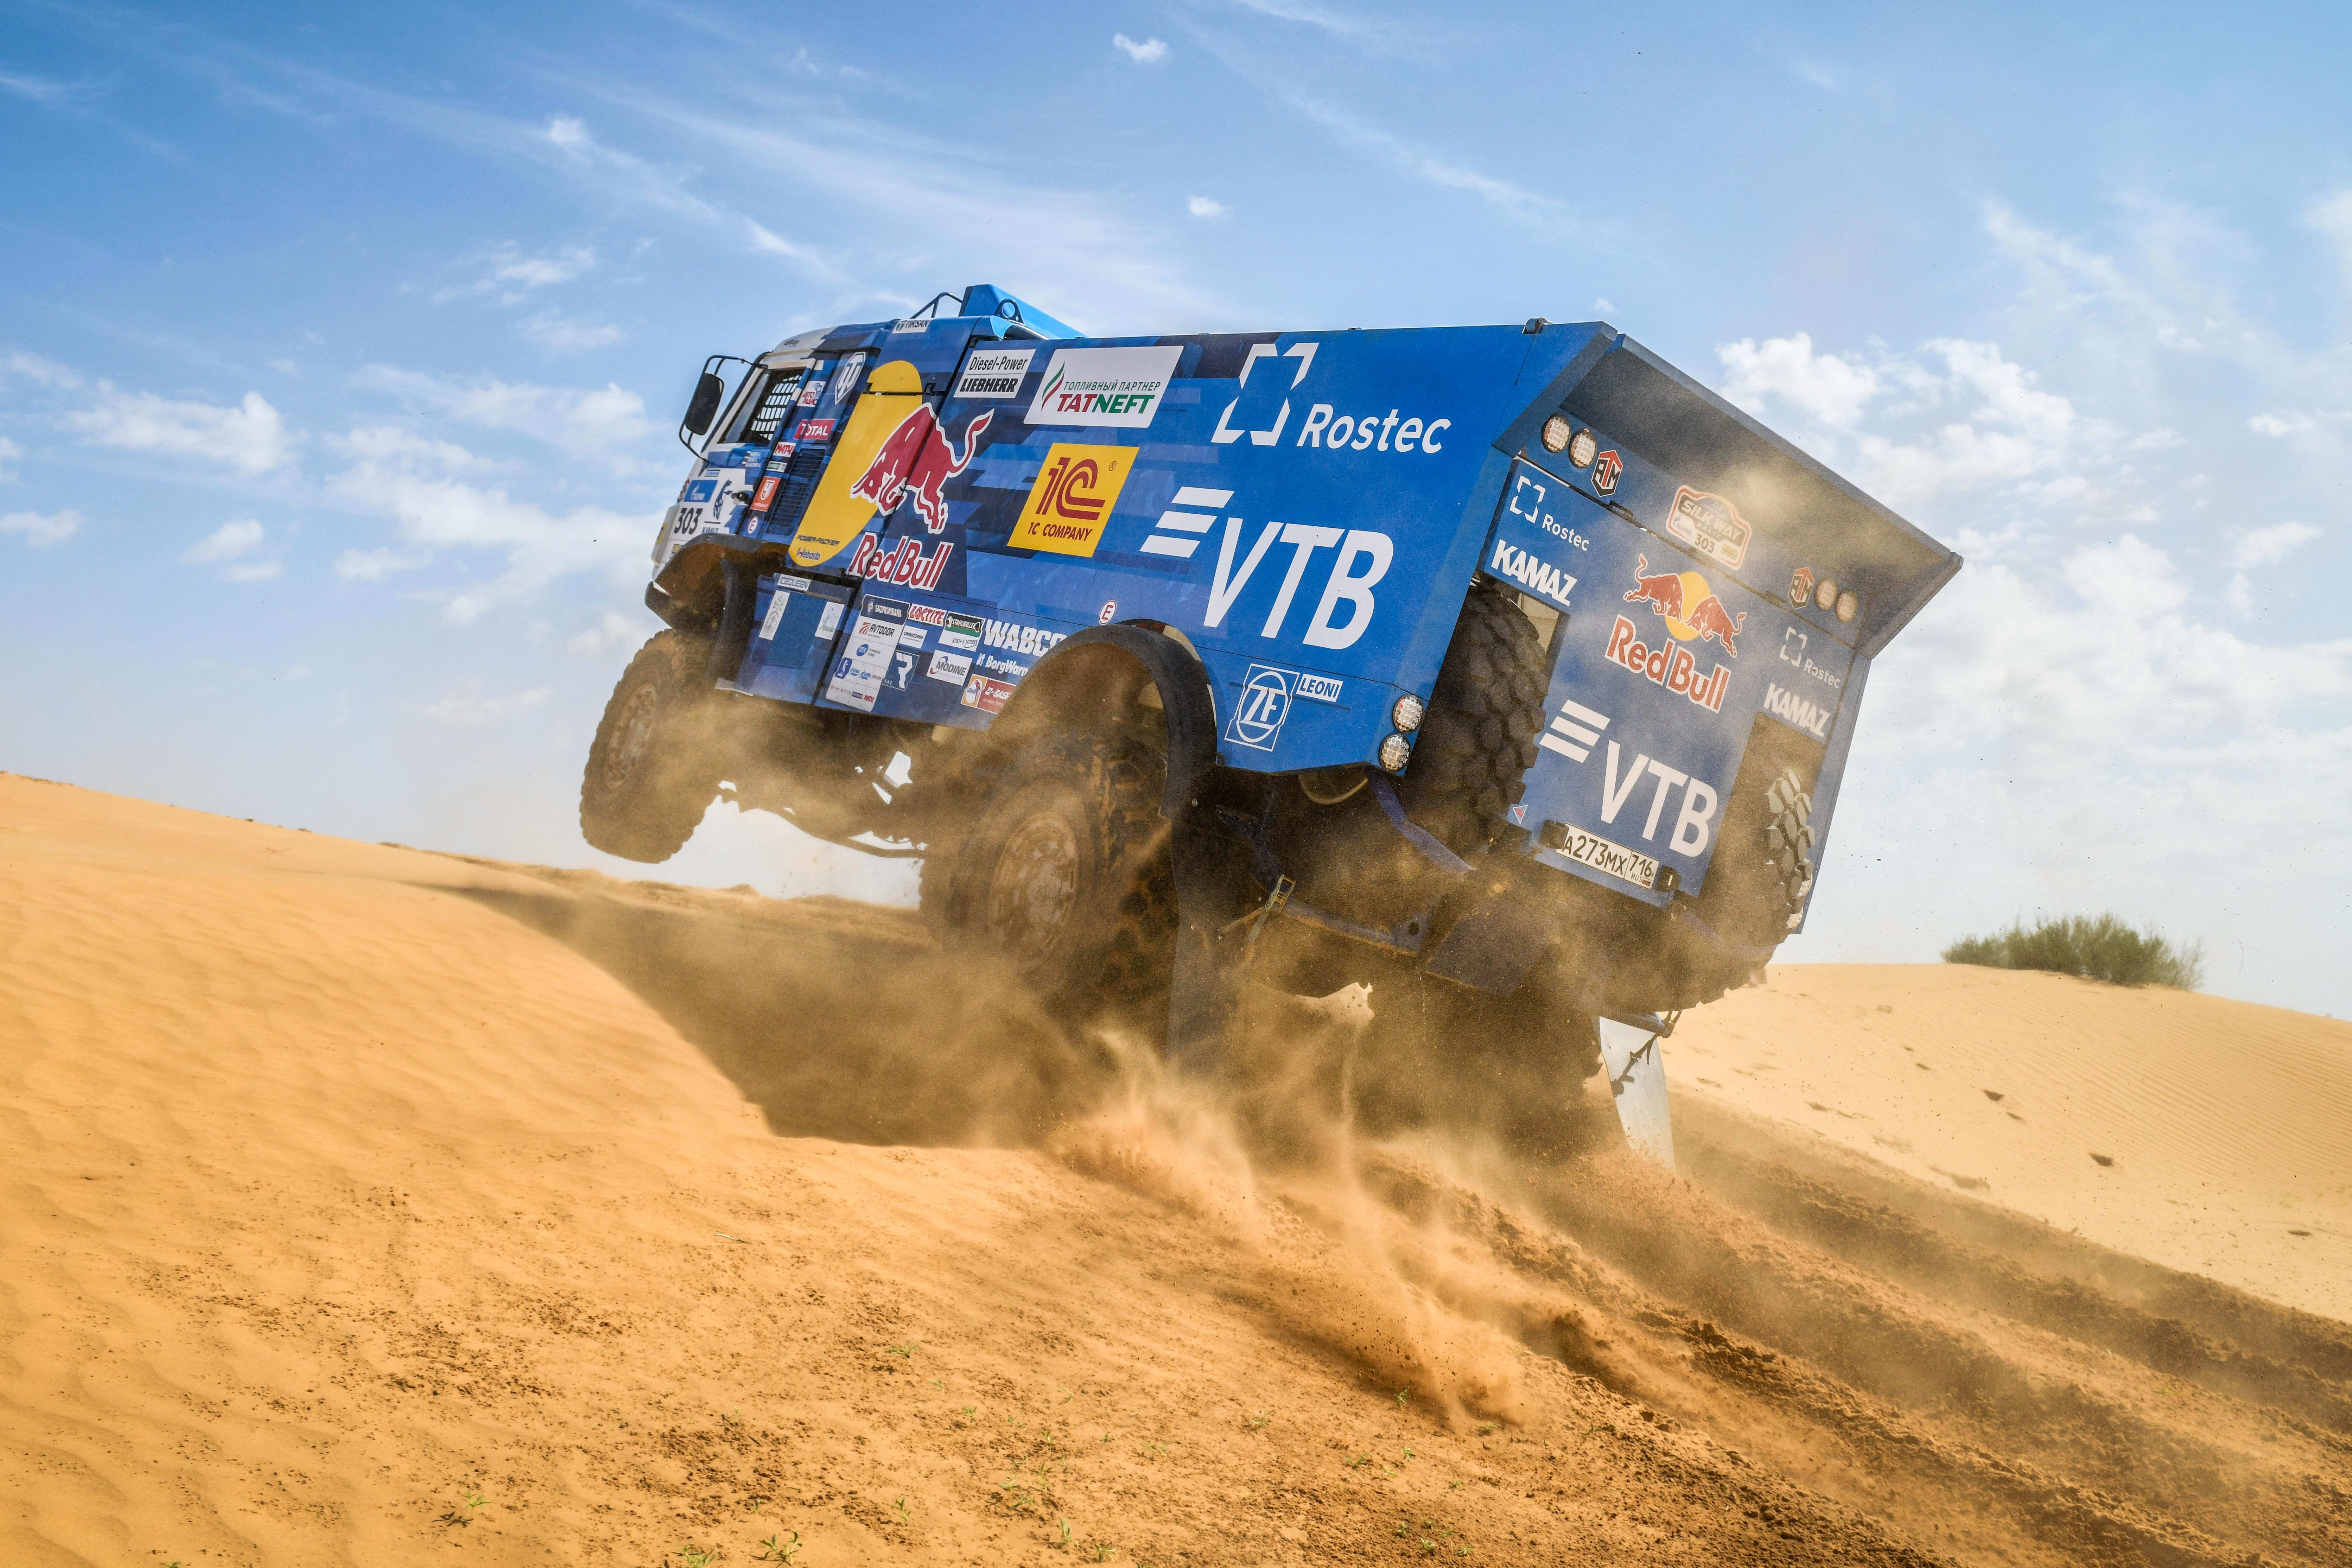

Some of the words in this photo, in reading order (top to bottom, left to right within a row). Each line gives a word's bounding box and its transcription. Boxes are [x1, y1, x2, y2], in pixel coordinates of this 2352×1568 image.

[969, 356, 1028, 370] Diesel-Power
[959, 378, 1018, 392] LIEBHERR
[1063, 379, 1118, 391] ТОПЛИВНЫЙ
[1118, 381, 1161, 391] ПАРТНЕР
[1057, 394, 1156, 414] TATNEFT
[801, 423, 828, 436] TOTAL
[1296, 404, 1451, 454] Rostec
[674, 507, 703, 535] 303
[1681, 500, 1714, 526] SILK
[1714, 519, 1742, 540] WAY
[1028, 522, 1037, 534] 1C
[1042, 523, 1092, 541] COMPANY
[1542, 513, 1590, 551] Rostec
[1694, 533, 1715, 553] 303
[796, 547, 820, 560] Webasto
[1491, 539, 1578, 607] KAMAZ
[1203, 517, 1394, 650] VTB
[875, 604, 902, 618] GAZPROMBANK
[910, 606, 945, 624] LOCTITE
[869, 624, 895, 637] AVTODOR
[903, 631, 924, 640] OMNICOMM
[936, 661, 967, 676] MODINE
[985, 655, 1029, 677] BorgWarn
[1804, 658, 1841, 688] Rostec
[1301, 678, 1339, 698] LEONI
[1239, 683, 1288, 729] ZF
[1763, 683, 1830, 737] KAMAZ
[1601, 739, 1718, 857] VTB
[1629, 854, 1653, 878] 716
[1631, 873, 1643, 883] RUS
